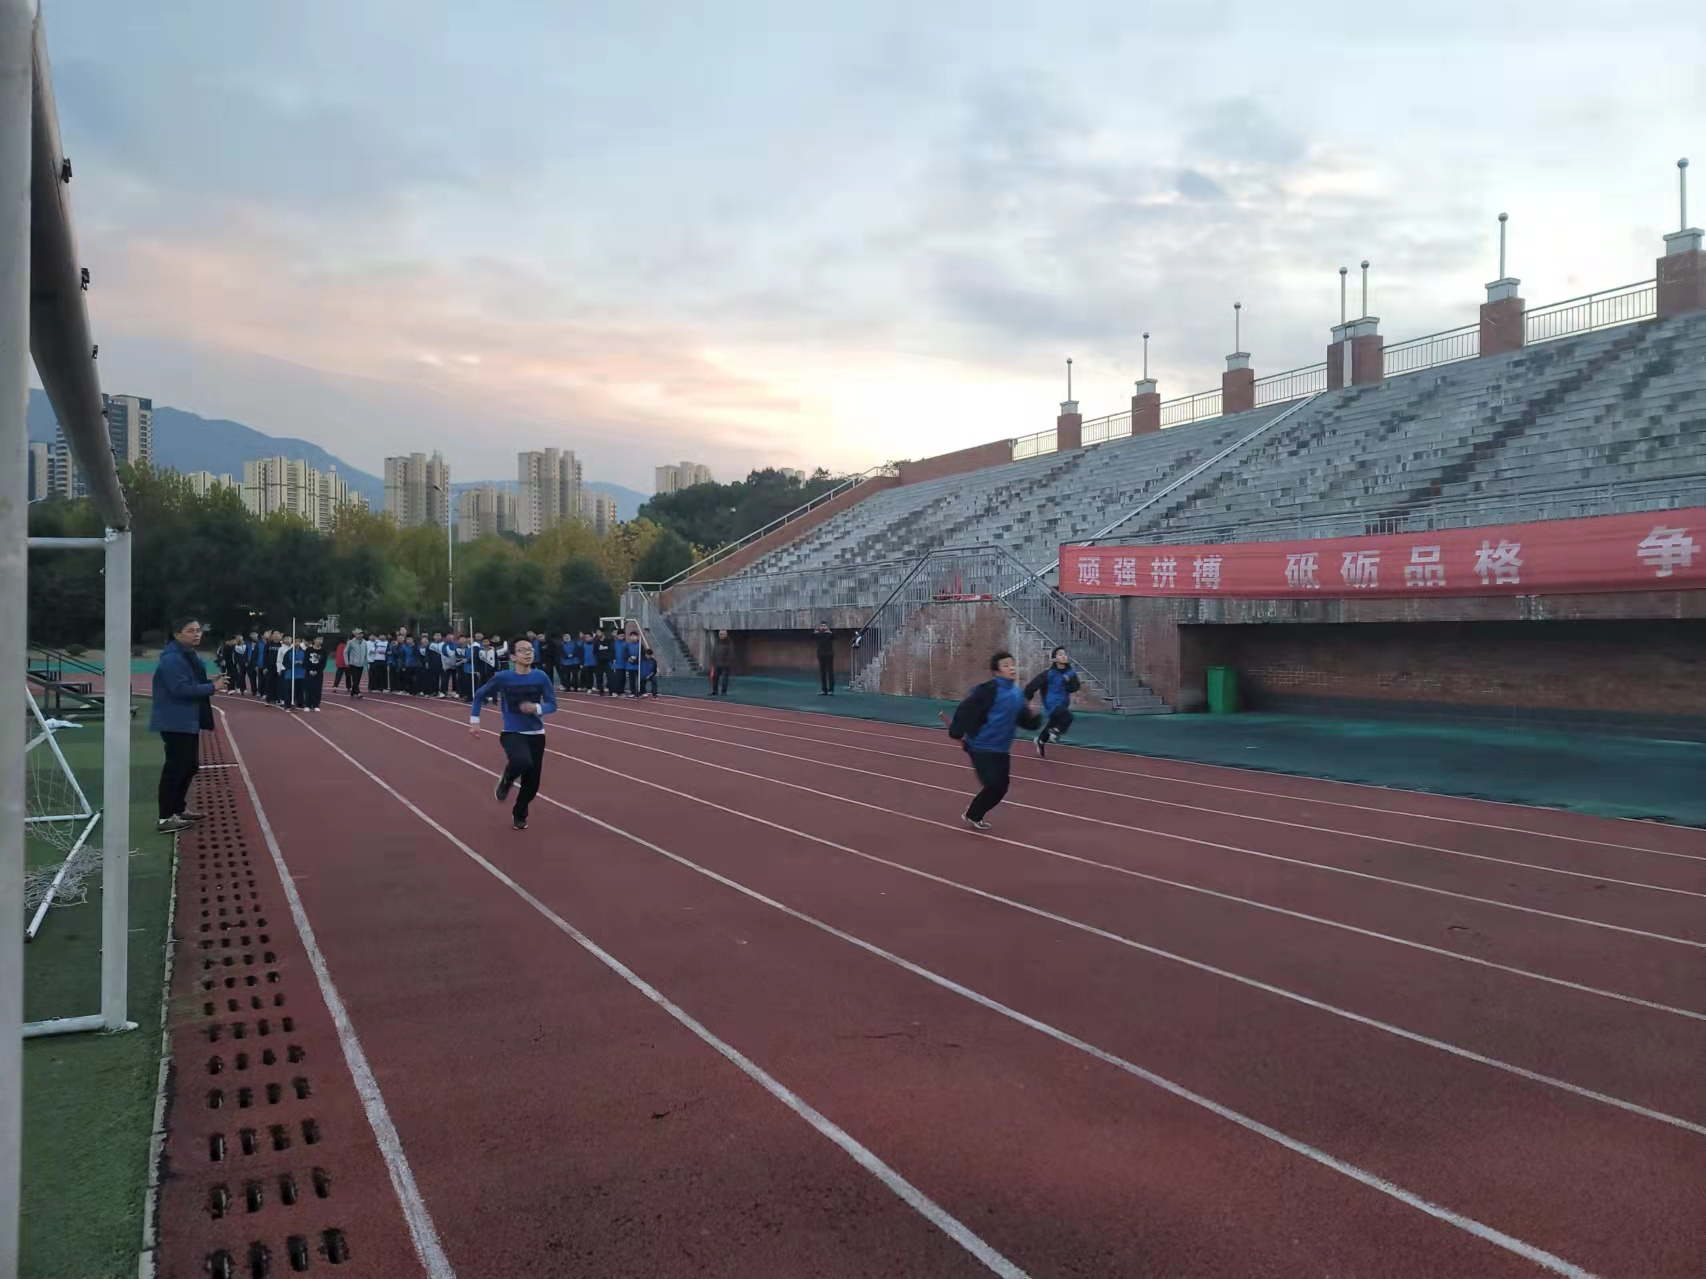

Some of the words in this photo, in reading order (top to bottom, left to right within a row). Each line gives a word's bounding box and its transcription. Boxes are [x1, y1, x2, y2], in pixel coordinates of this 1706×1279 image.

[1078, 554, 1223, 590] 顽强拼搏
[1285, 539, 1524, 590] 砥砺品格
[1637, 525, 1701, 578] 争
